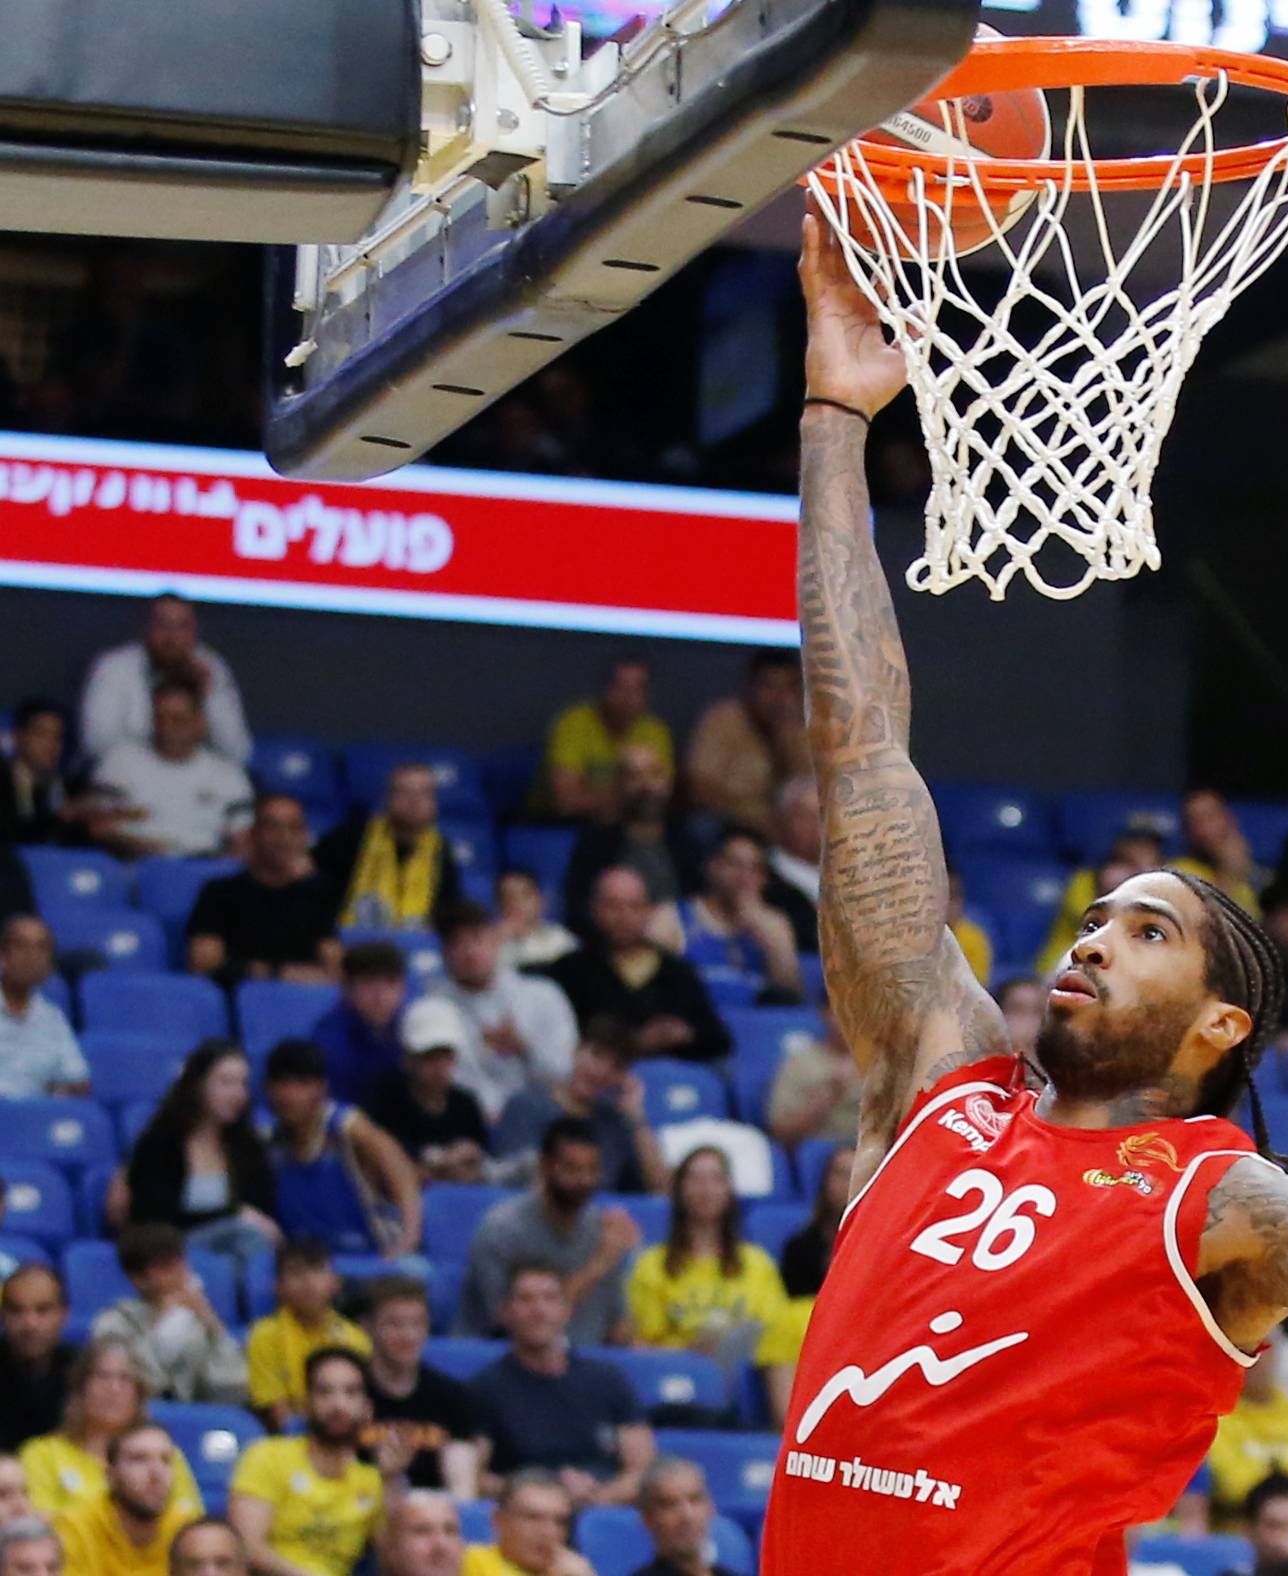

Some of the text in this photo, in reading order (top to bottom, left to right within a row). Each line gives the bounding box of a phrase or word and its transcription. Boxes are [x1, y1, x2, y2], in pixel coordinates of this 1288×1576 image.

[232, 493, 455, 575] פועלים
[909, 1168, 1057, 1271] 26
[785, 1450, 962, 1510] אלטשולר שחם
